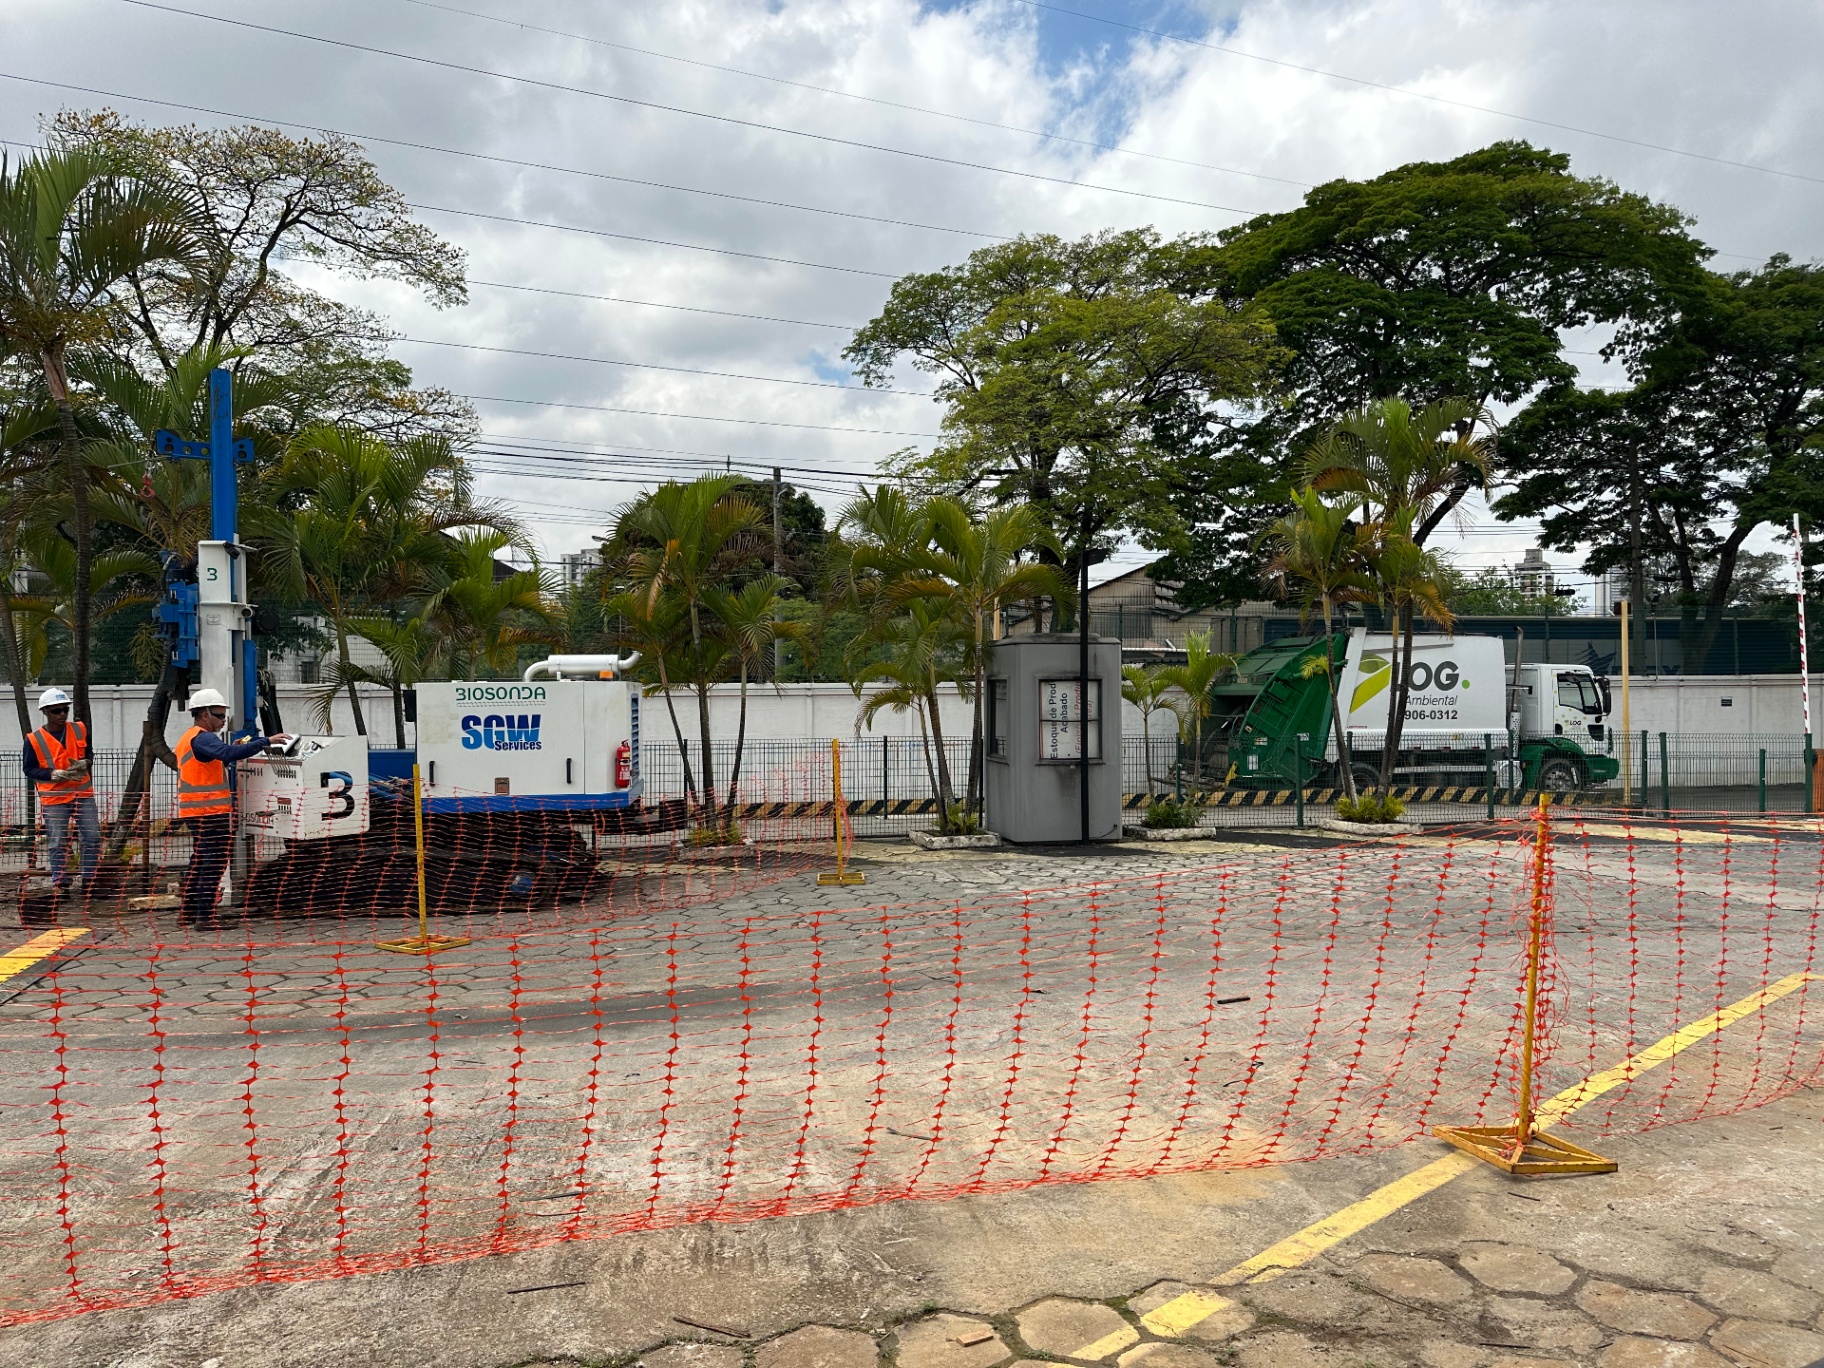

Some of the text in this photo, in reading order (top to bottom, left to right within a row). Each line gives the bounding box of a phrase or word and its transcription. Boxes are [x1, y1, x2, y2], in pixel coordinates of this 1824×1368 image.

[456, 686, 546, 701] BIOSONDA
[1405, 694, 1458, 706] Ambiental
[1049, 707, 1057, 719] de
[1060, 692, 1068, 733] Acabado
[461, 714, 542, 750] SGW
[494, 740, 542, 751] Services
[1050, 720, 1059, 760] Estoque
